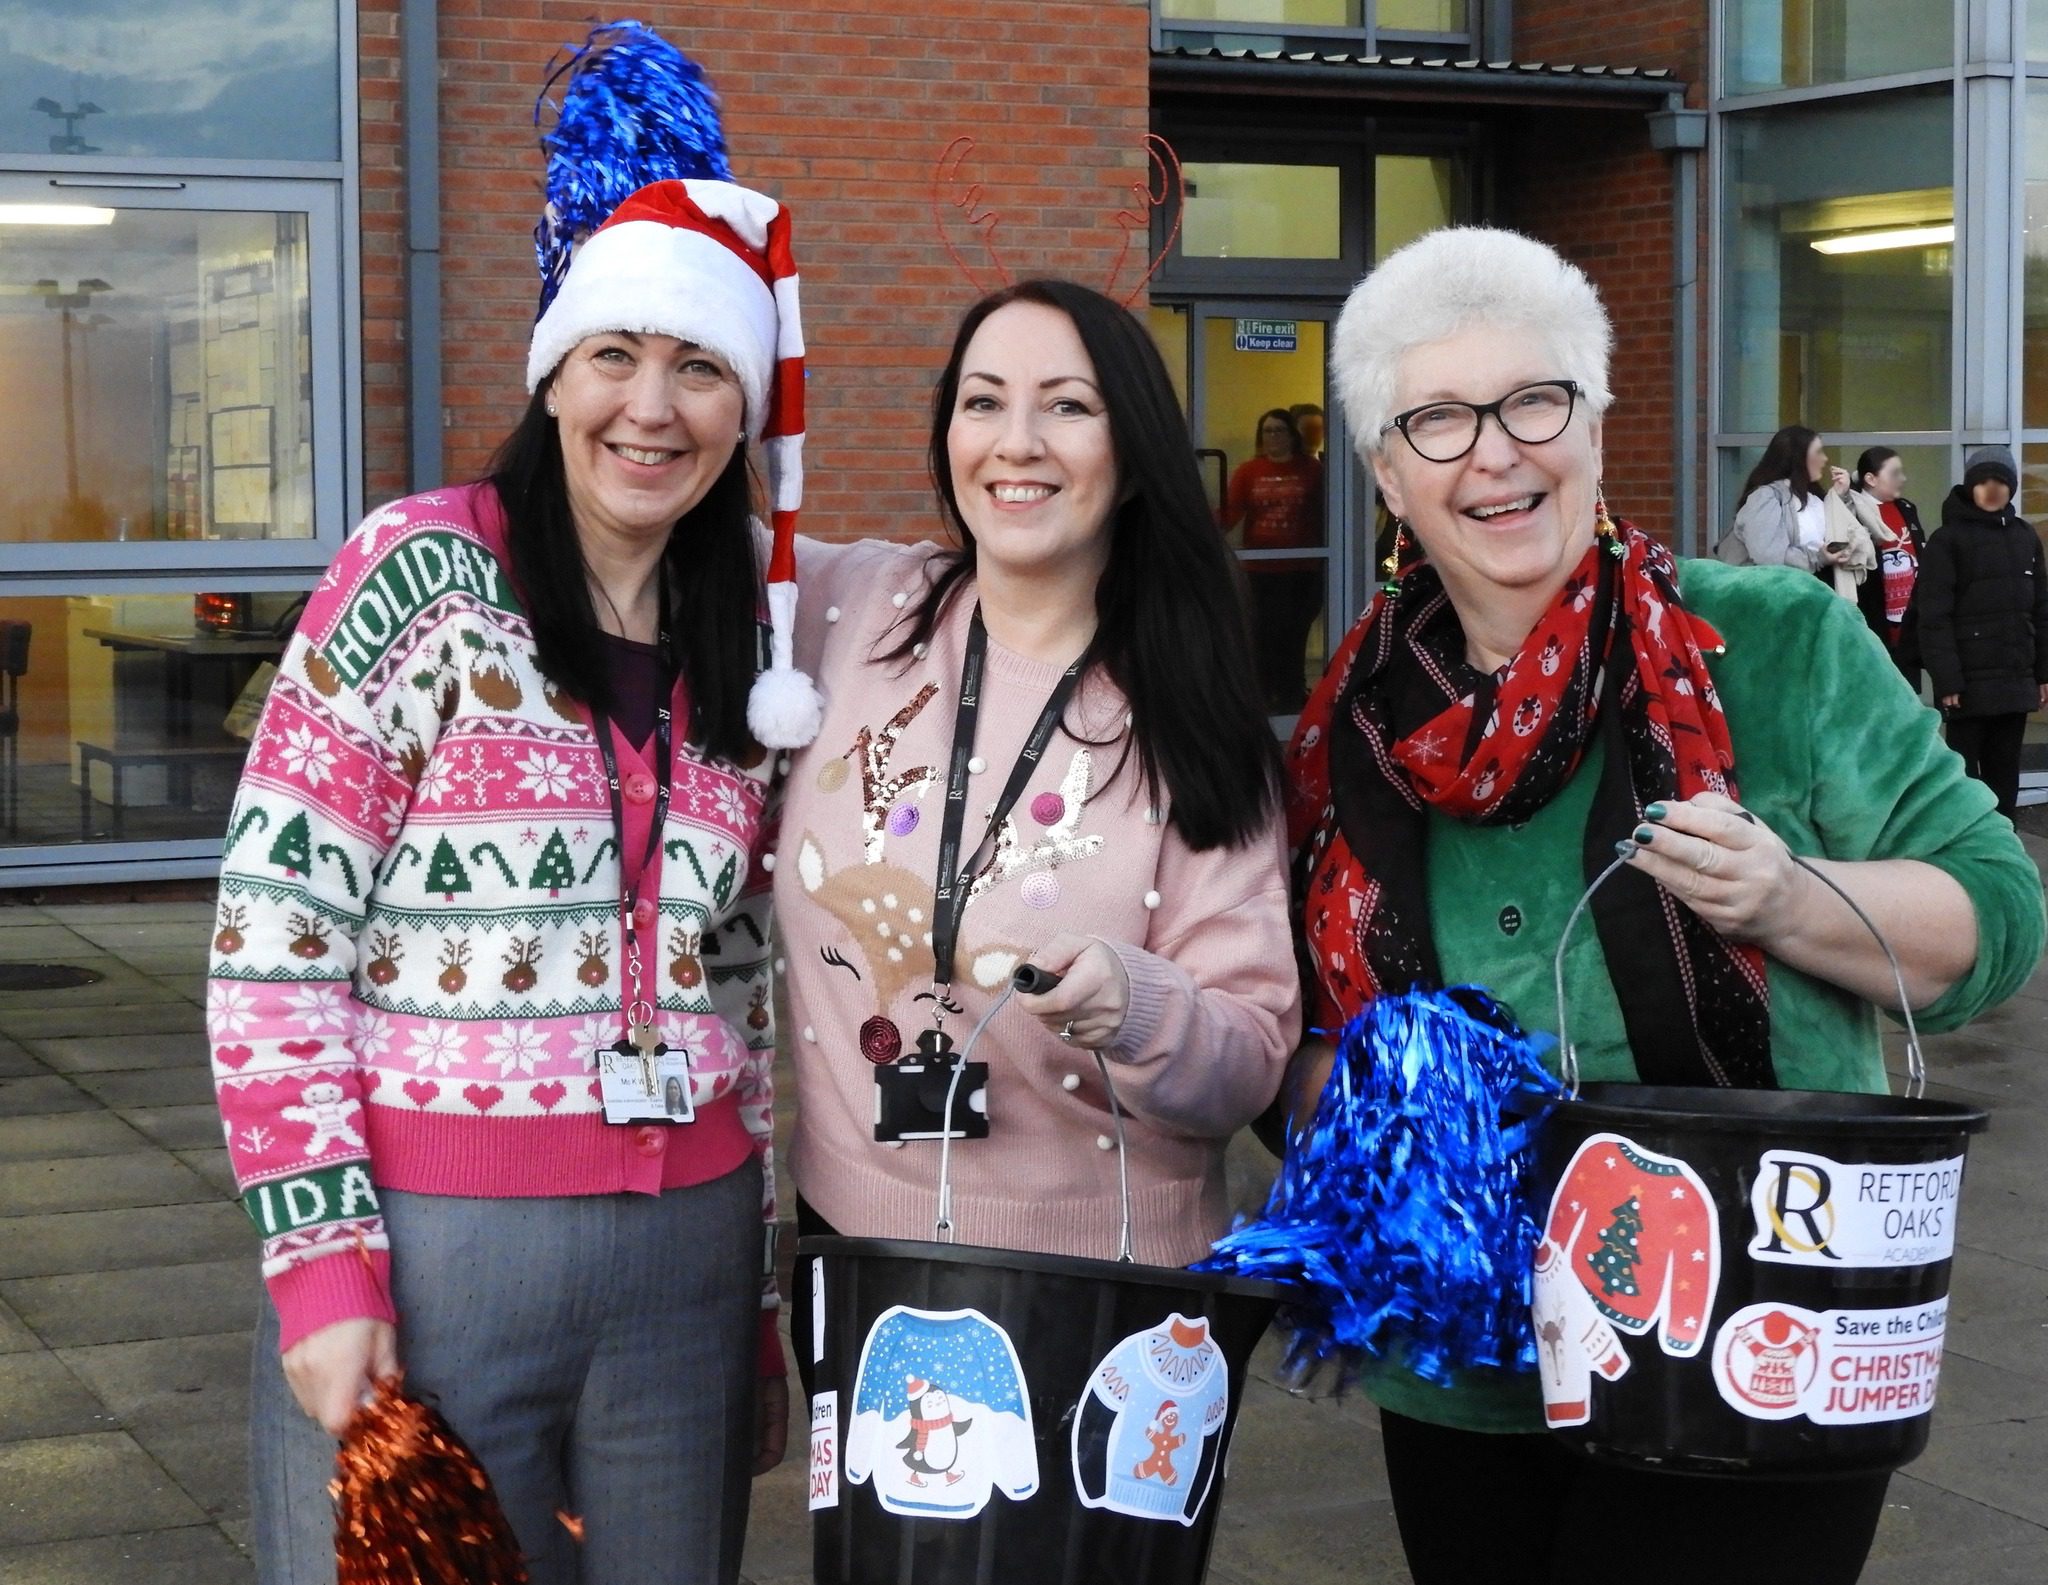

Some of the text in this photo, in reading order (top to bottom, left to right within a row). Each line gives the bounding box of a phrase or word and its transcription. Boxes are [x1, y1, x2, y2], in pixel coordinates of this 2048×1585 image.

[1249, 337, 1294, 349] Keep clear
[1252, 322, 1295, 335] Fire exit
[330, 537, 498, 680] HOLIDAY
[258, 1166, 380, 1233] IDA
[1859, 1169, 1958, 1202] RETFORD
[1884, 1207, 1944, 1239] OAKS
[1835, 1315, 1881, 1336] Save
[1886, 1315, 1913, 1335] the
[1824, 1383, 1920, 1412] JUMPER
[811, 1470, 832, 1500] DAY
